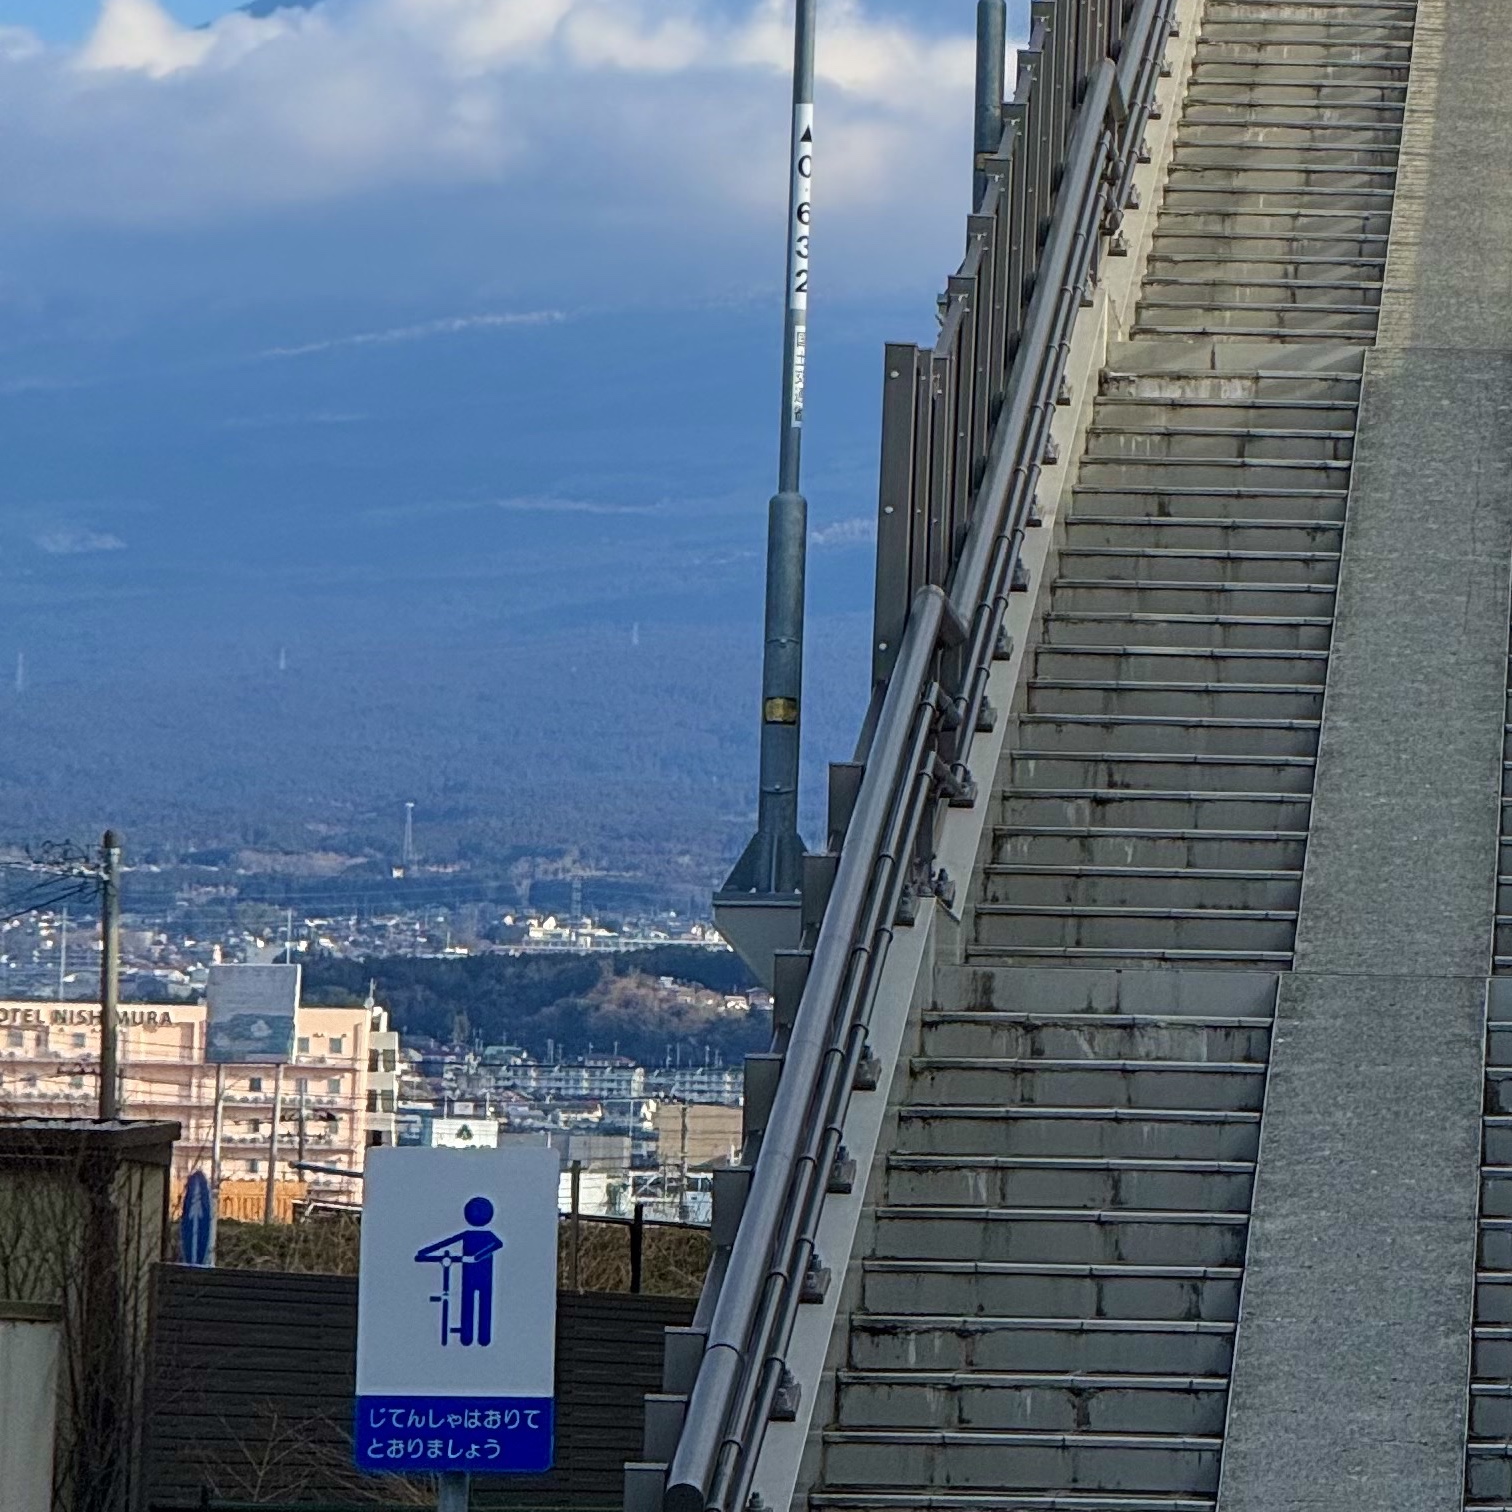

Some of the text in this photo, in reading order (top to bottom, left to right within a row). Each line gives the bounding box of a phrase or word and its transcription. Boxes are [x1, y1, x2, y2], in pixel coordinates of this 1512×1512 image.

[369, 1407, 541, 1429] じてんしゃはおりて
[367, 1437, 501, 1459] とおりましょう
